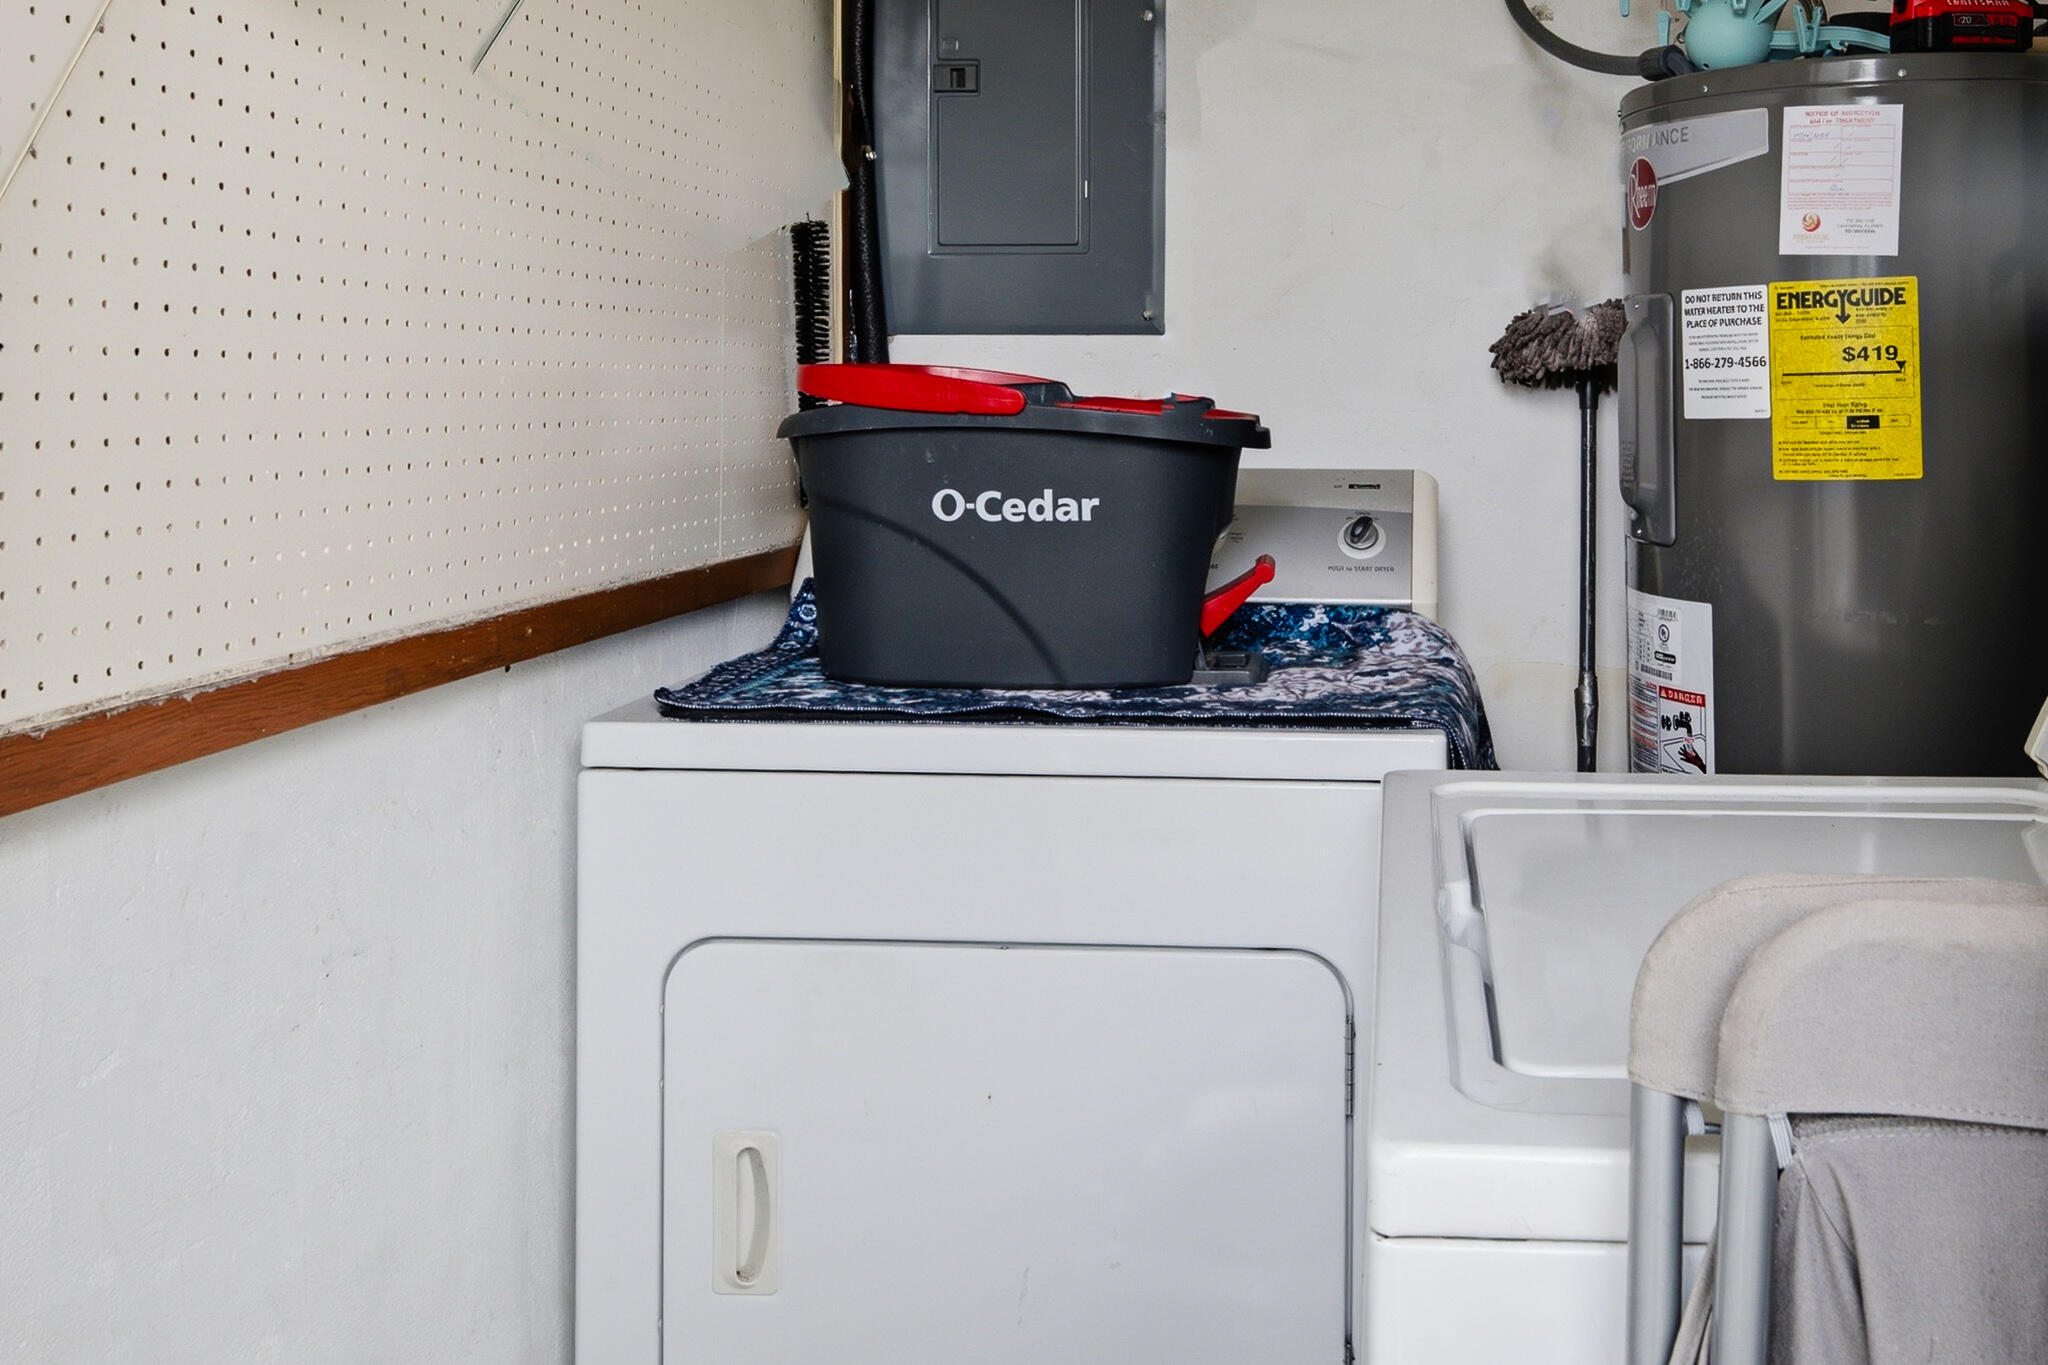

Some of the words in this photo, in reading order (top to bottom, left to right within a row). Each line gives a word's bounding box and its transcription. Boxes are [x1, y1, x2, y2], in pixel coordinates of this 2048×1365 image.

[1685, 295, 1695, 304] DO
[1696, 294, 1710, 303] NOT
[1712, 293, 1742, 302] RETURN
[1743, 291, 1763, 300] THIS
[1684, 307, 1706, 316] WATER
[1707, 305, 1735, 315] HEATER
[1737, 305, 1748, 313] TO
[1748, 304, 1765, 313] THE
[1686, 319, 1707, 328] PLACE
[1708, 319, 1718, 327] OF
[1719, 317, 1762, 327] PURCHASE
[1842, 345, 1898, 362] $419
[1685, 356, 1767, 369] 1-866-279-4566
[931, 488, 1100, 522] O-Cedar
[1668, 690, 1703, 704] DANGER
